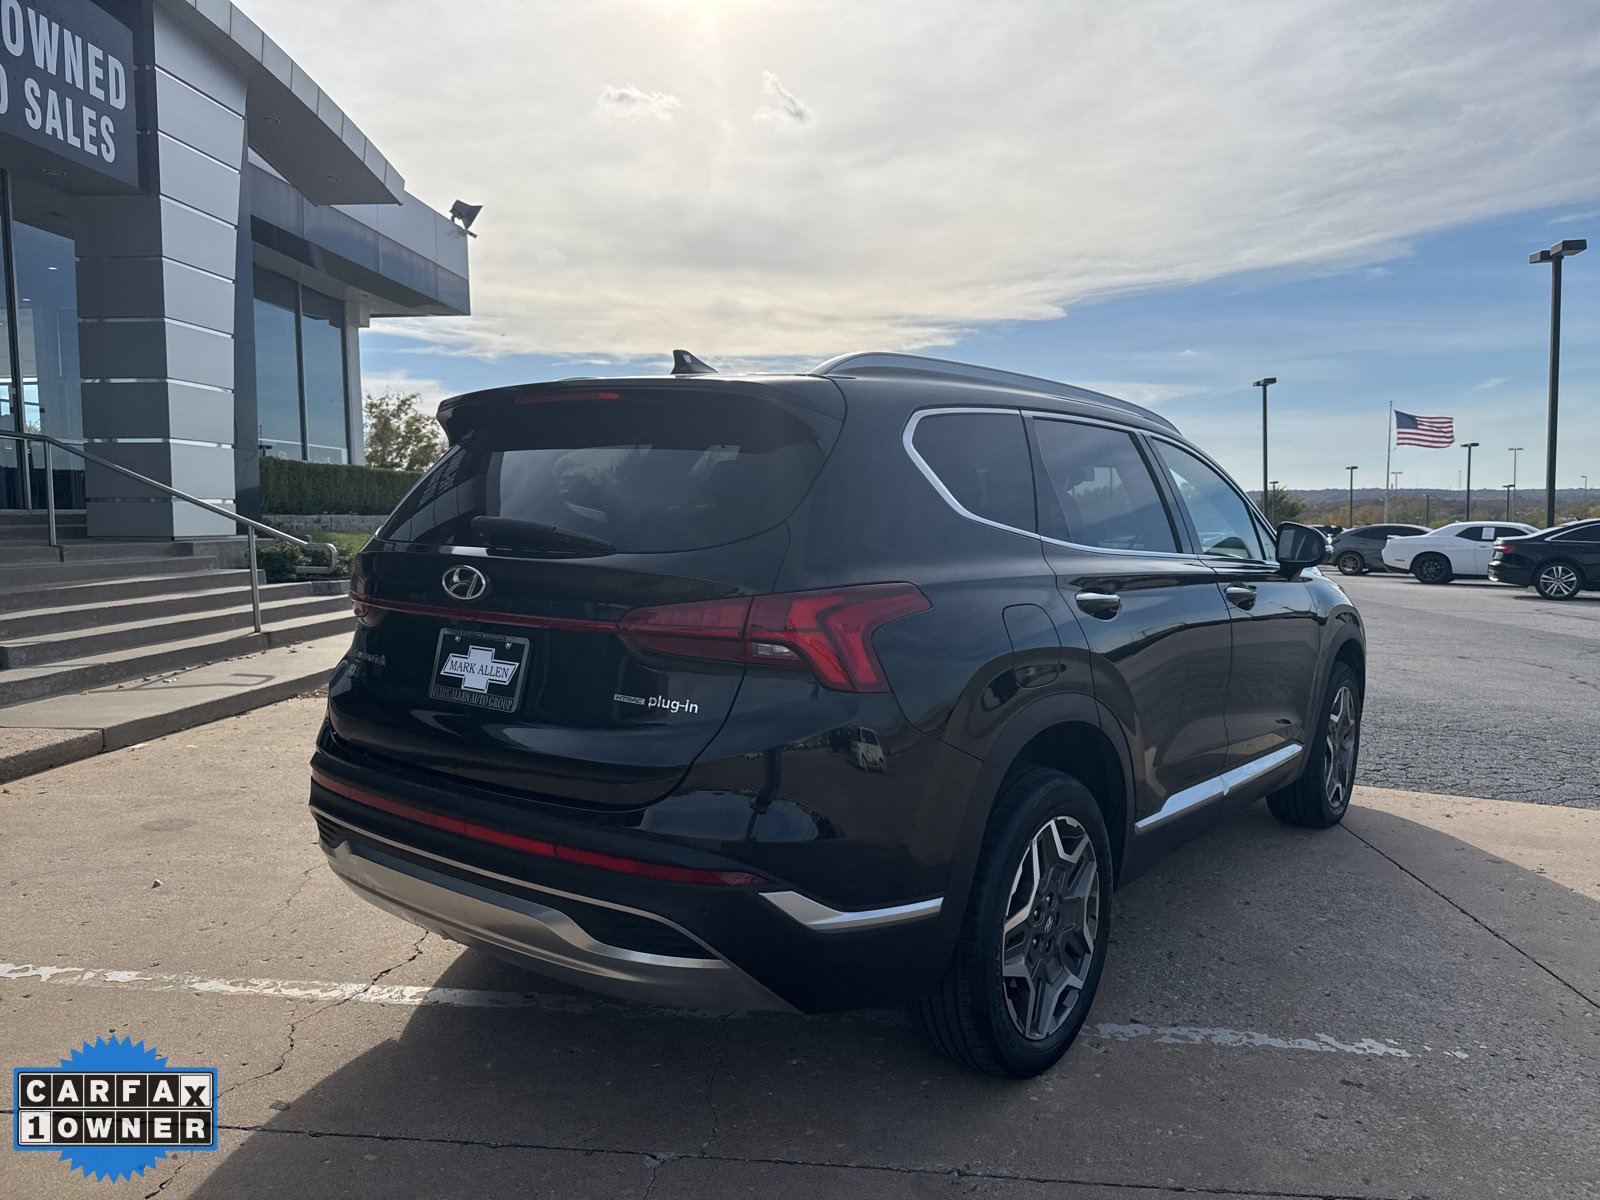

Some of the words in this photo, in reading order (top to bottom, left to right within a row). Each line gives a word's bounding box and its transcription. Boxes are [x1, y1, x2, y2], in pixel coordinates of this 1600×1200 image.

[1, 0, 126, 110] OWNED
[24, 77, 116, 163] SALES
[449, 660, 476, 674] MARK
[477, 664, 509, 679] ALLEN
[450, 690, 470, 703] ALLEN
[470, 693, 489, 705] AUTO
[488, 696, 513, 711] GROUP
[648, 695, 699, 714] plug-in
